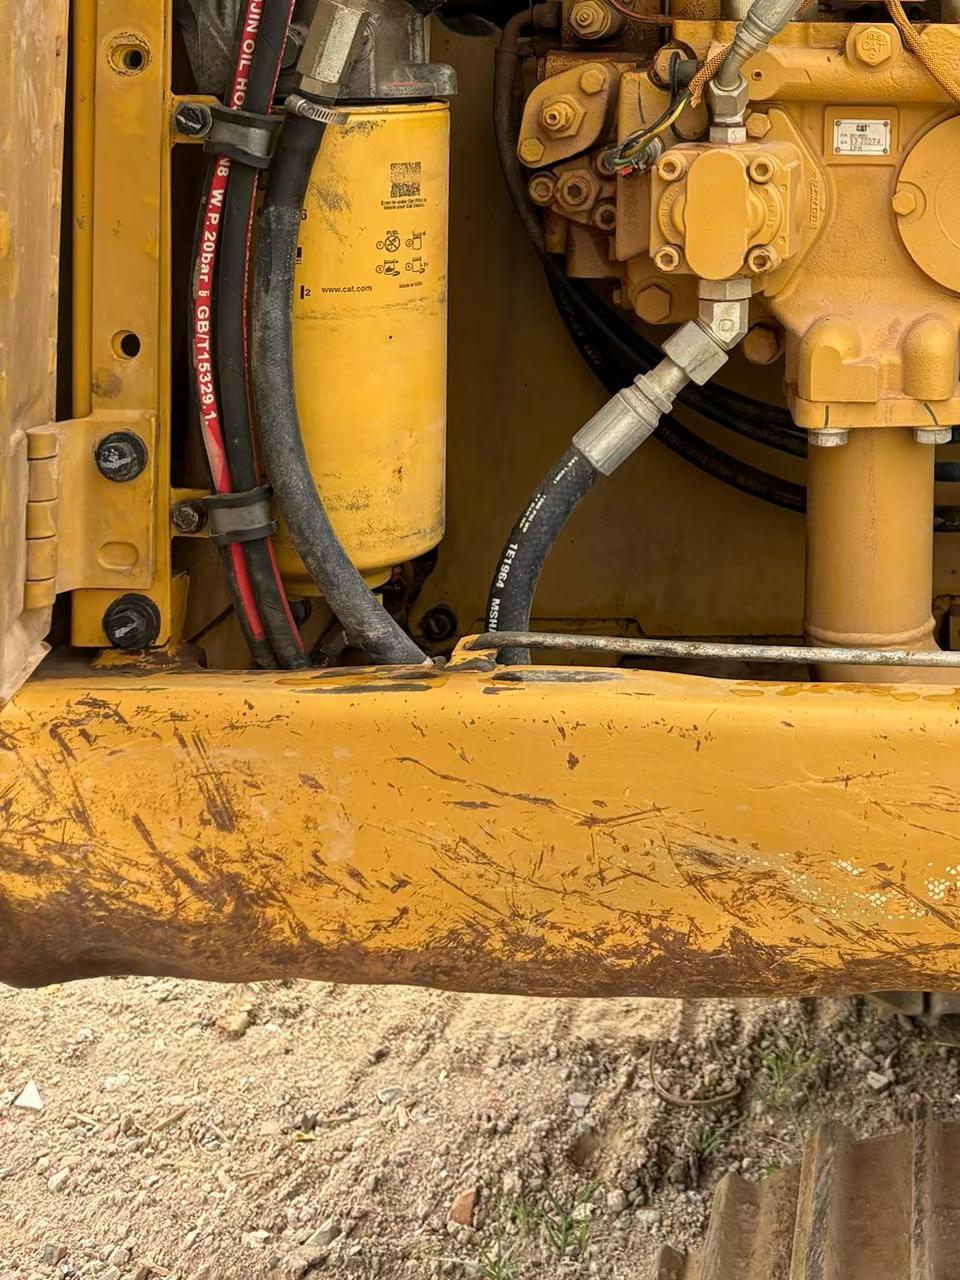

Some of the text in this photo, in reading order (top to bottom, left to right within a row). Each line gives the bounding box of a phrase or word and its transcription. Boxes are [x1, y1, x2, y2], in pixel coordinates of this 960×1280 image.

[238, 39, 256, 71] OIL
[230, 77, 249, 111] HO
[856, 124, 868, 132] CAT
[304, 288, 311, 297] 2
[321, 285, 373, 293] www.cat.com
[495, 542, 519, 589] 1E1964
